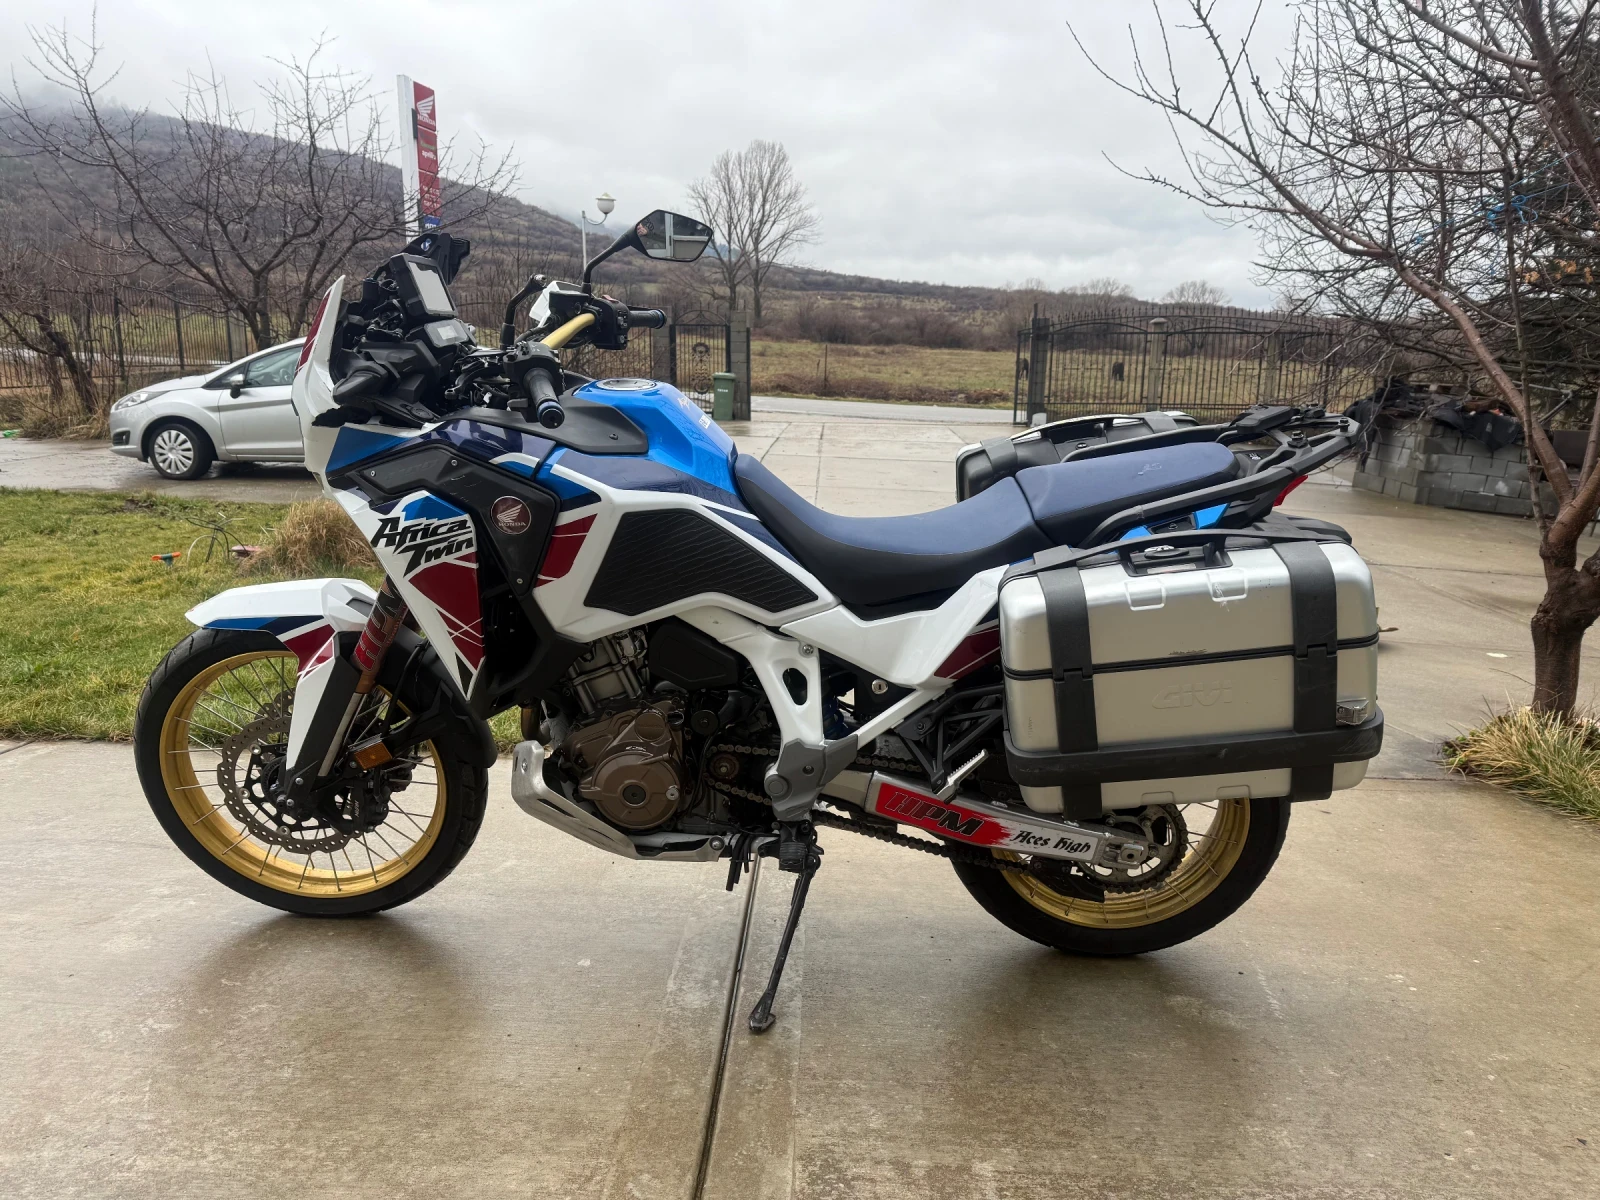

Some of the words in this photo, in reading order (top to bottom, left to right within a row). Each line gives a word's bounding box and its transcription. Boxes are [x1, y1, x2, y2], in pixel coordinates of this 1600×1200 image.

[417, 113, 436, 126] HONDA
[370, 517, 472, 555] Africa
[397, 530, 474, 578] Twin
[884, 791, 985, 836] HPM
[1010, 830, 1051, 847] Aces
